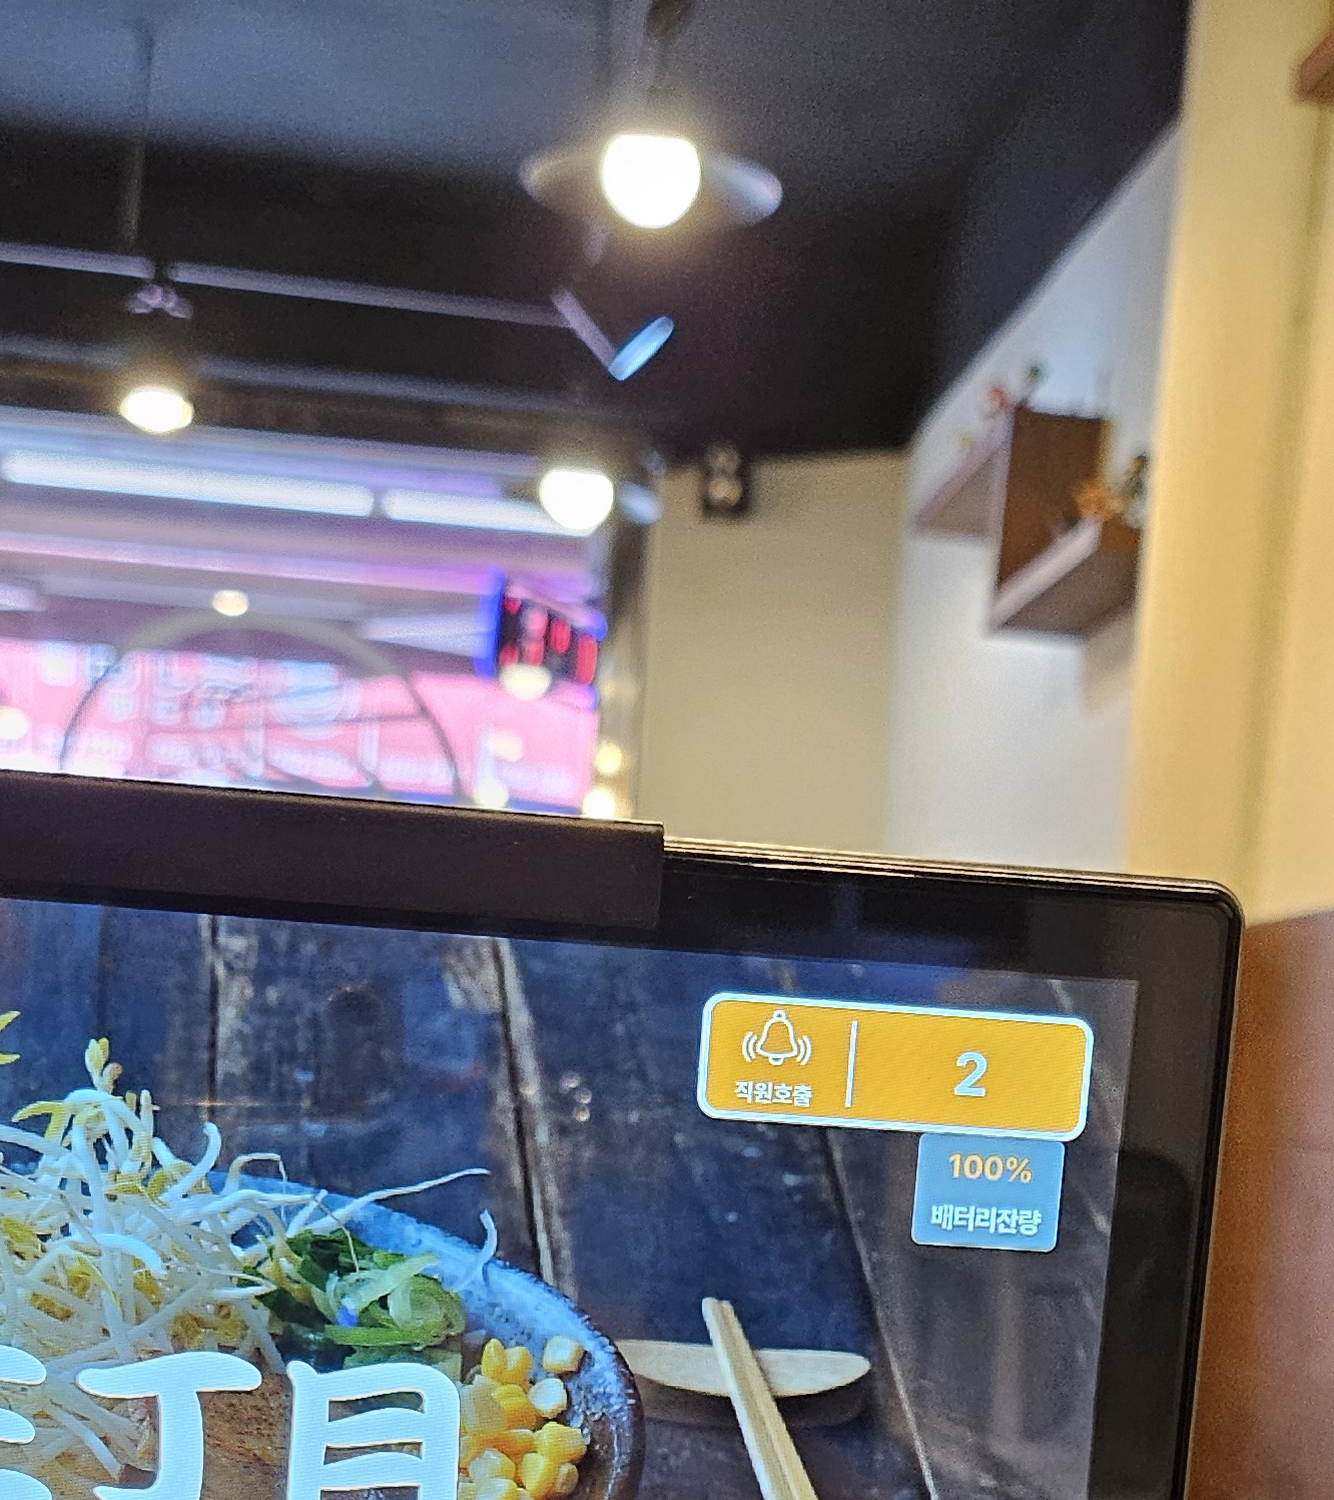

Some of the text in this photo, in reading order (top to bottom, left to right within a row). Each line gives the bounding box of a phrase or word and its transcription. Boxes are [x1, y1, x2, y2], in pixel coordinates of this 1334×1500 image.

[954, 1051, 988, 1097] 2
[734, 1080, 813, 1107] 직원호출
[949, 1152, 1033, 1184] 100%
[930, 1203, 1043, 1237] 배터리잔량
